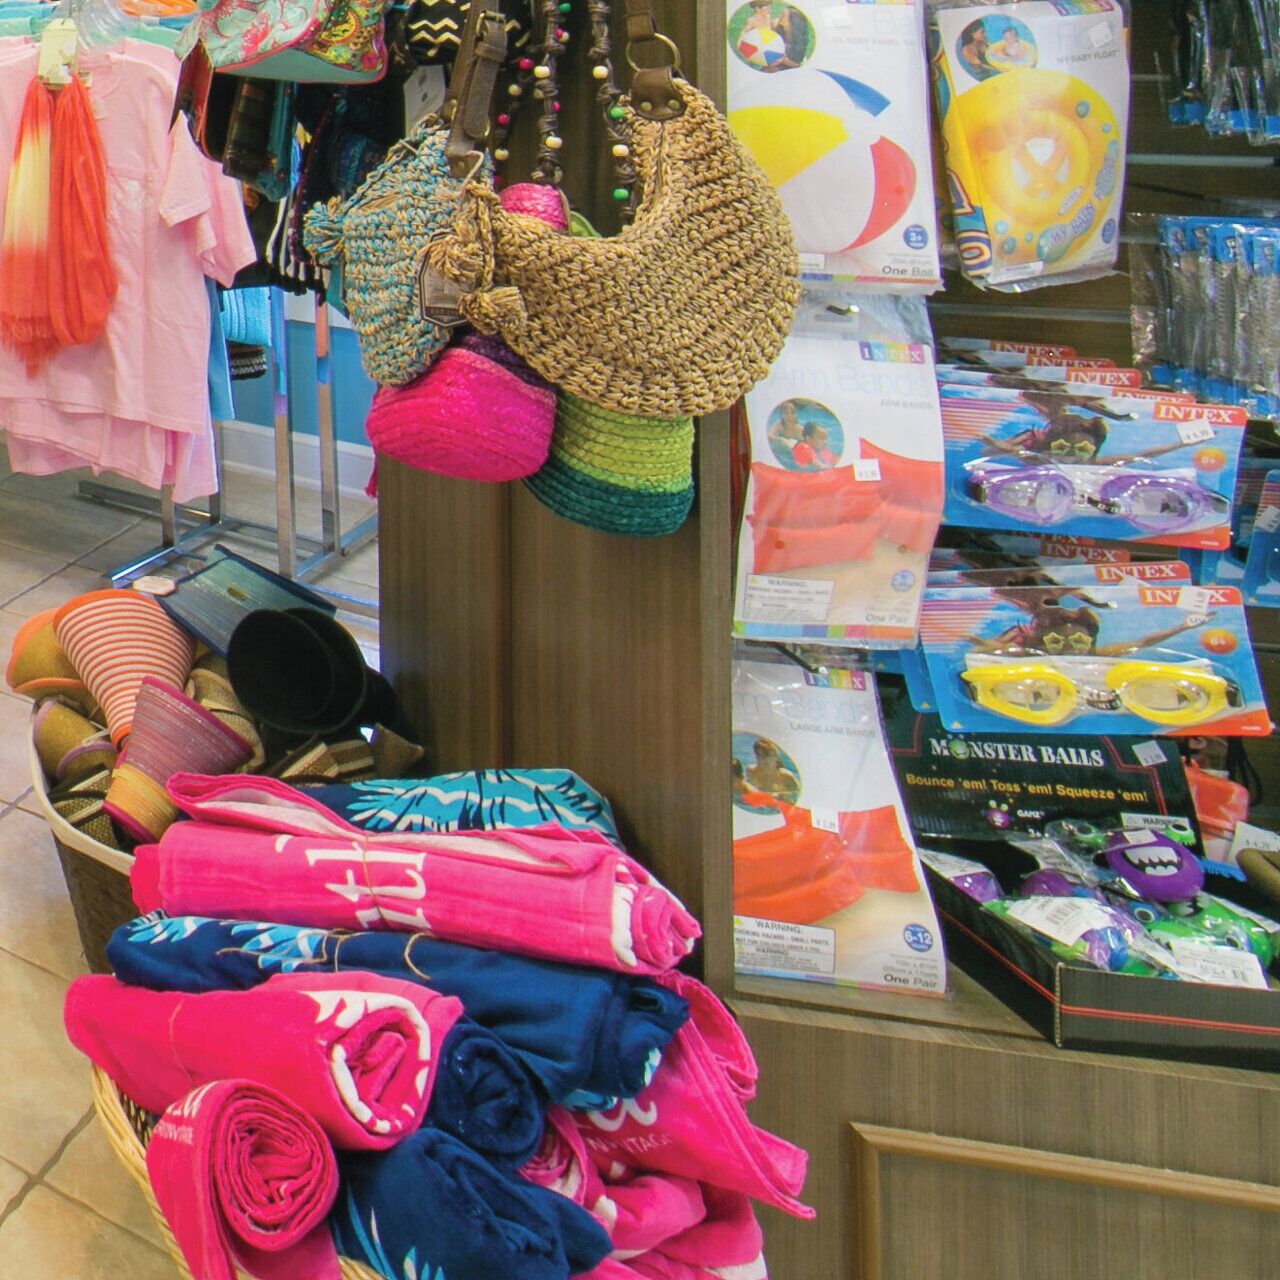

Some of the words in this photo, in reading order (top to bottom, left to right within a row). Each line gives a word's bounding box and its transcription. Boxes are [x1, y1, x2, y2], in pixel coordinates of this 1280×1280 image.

[881, 265, 909, 276] One
[911, 266, 934, 278] Ball
[862, 345, 923, 363] INTEX
[1069, 371, 1133, 386] INTEX
[1158, 405, 1236, 424] INTEX
[1046, 543, 1119, 563] INTEX
[1101, 564, 1177, 580] INTEX
[1145, 589, 1229, 604] INTX
[865, 612, 886, 623] One
[806, 671, 864, 689] INTEX
[790, 722, 824, 734] LARGE
[824, 725, 845, 737] ARM
[845, 726, 877, 738] BANDS
[1040, 745, 1105, 768] BALLS
[905, 772, 956, 790] Bounce
[957, 777, 988, 792] 'em!
[989, 778, 1023, 794] Toss
[1023, 780, 1054, 797] 'em!
[1055, 782, 1116, 801] Squeeze
[1117, 788, 1150, 804] 'em!
[904, 929, 933, 946] 6-12
[883, 973, 910, 985] One
[912, 976, 938, 989] Pair
